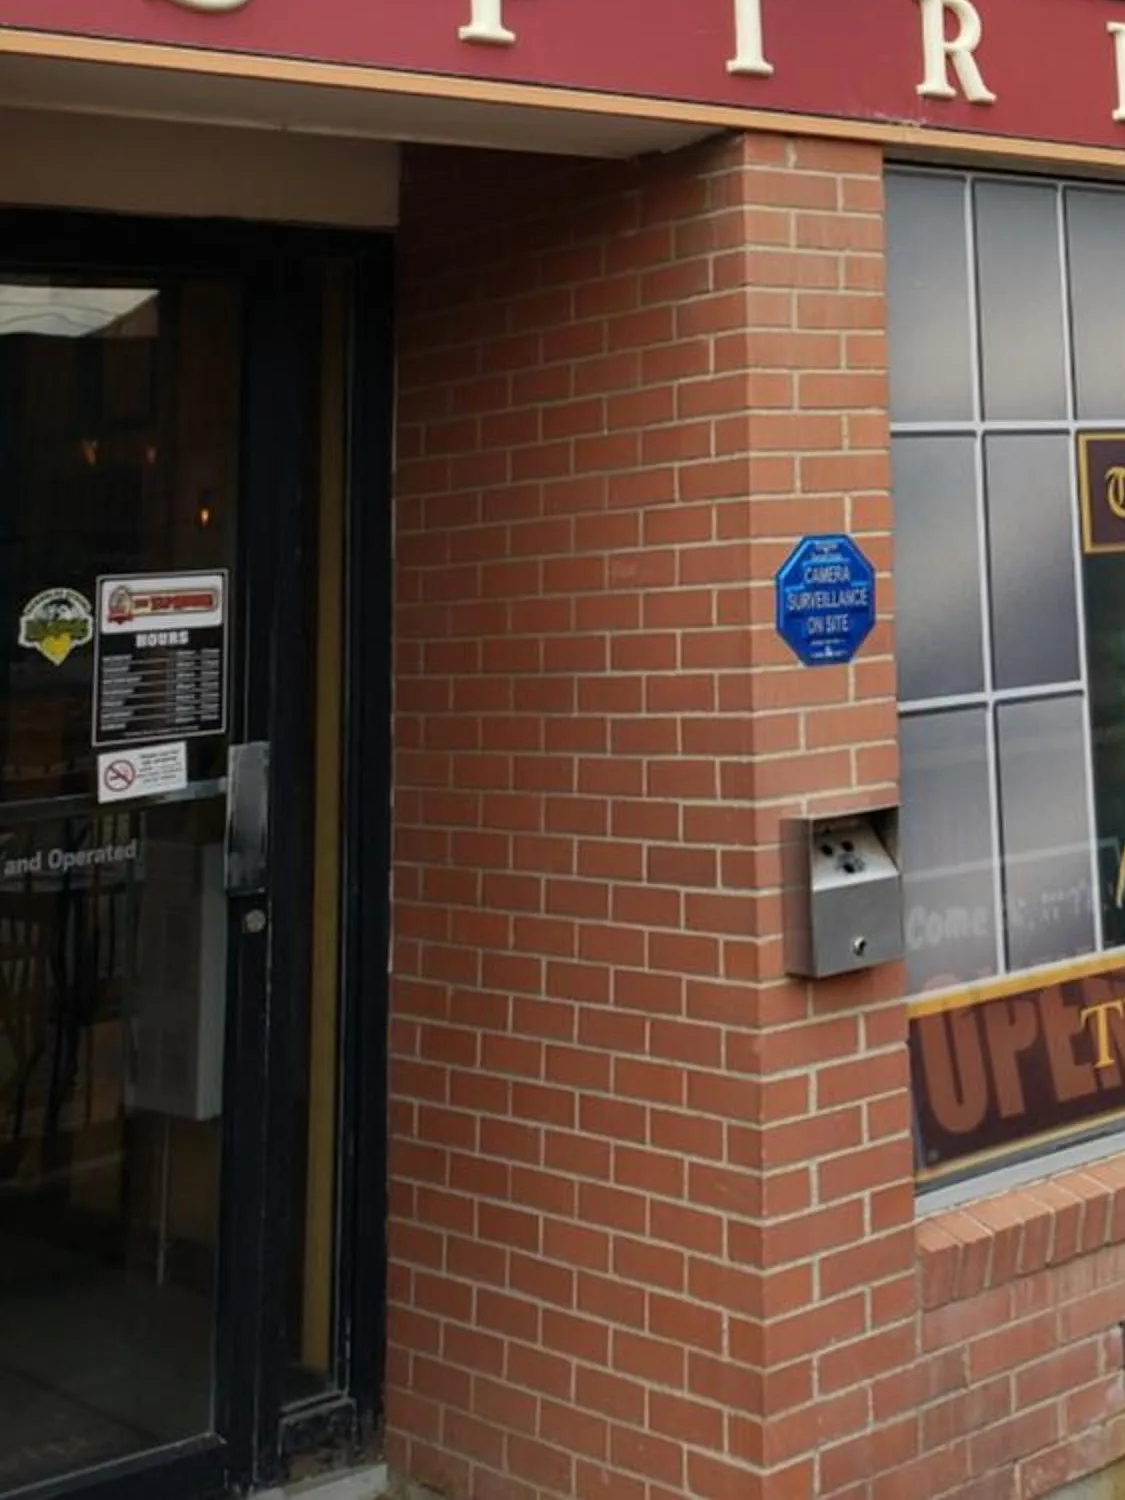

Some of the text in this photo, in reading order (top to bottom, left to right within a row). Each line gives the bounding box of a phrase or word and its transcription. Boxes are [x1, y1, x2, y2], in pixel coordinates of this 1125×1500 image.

[804, 565, 851, 584] CAMERA
[787, 588, 869, 611] SURVEILLANCE
[807, 613, 850, 636] ON SITE
[136, 630, 190, 649] HOURS
[4, 838, 138, 876] and Operated
